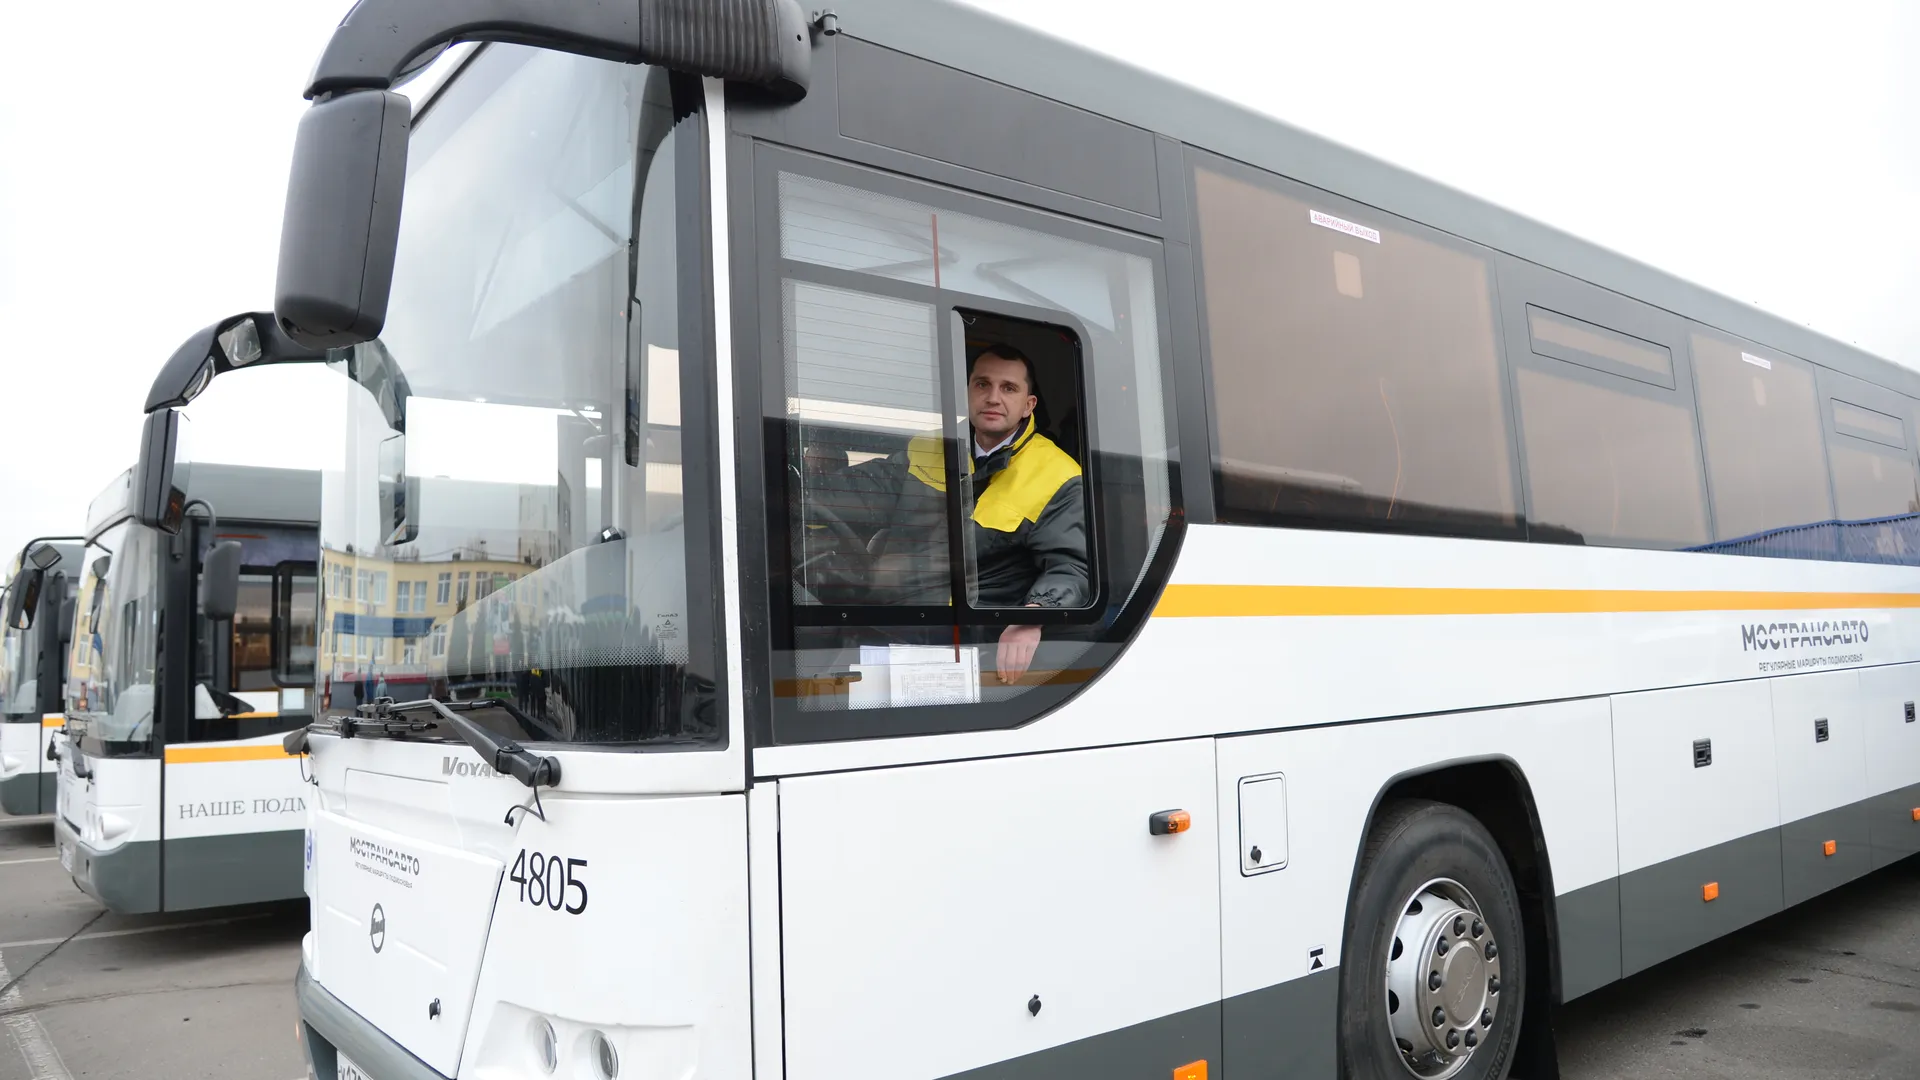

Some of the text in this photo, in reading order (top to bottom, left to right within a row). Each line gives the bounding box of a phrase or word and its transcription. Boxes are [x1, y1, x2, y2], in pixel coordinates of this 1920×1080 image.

[1741, 620, 1869, 652] МОСТРАНСАВТО
[442, 756, 515, 779] VOYA
[178, 800, 246, 819] НАШЕ
[349, 836, 420, 876] МОСТРАНСАВТО
[510, 848, 588, 915] 4805
